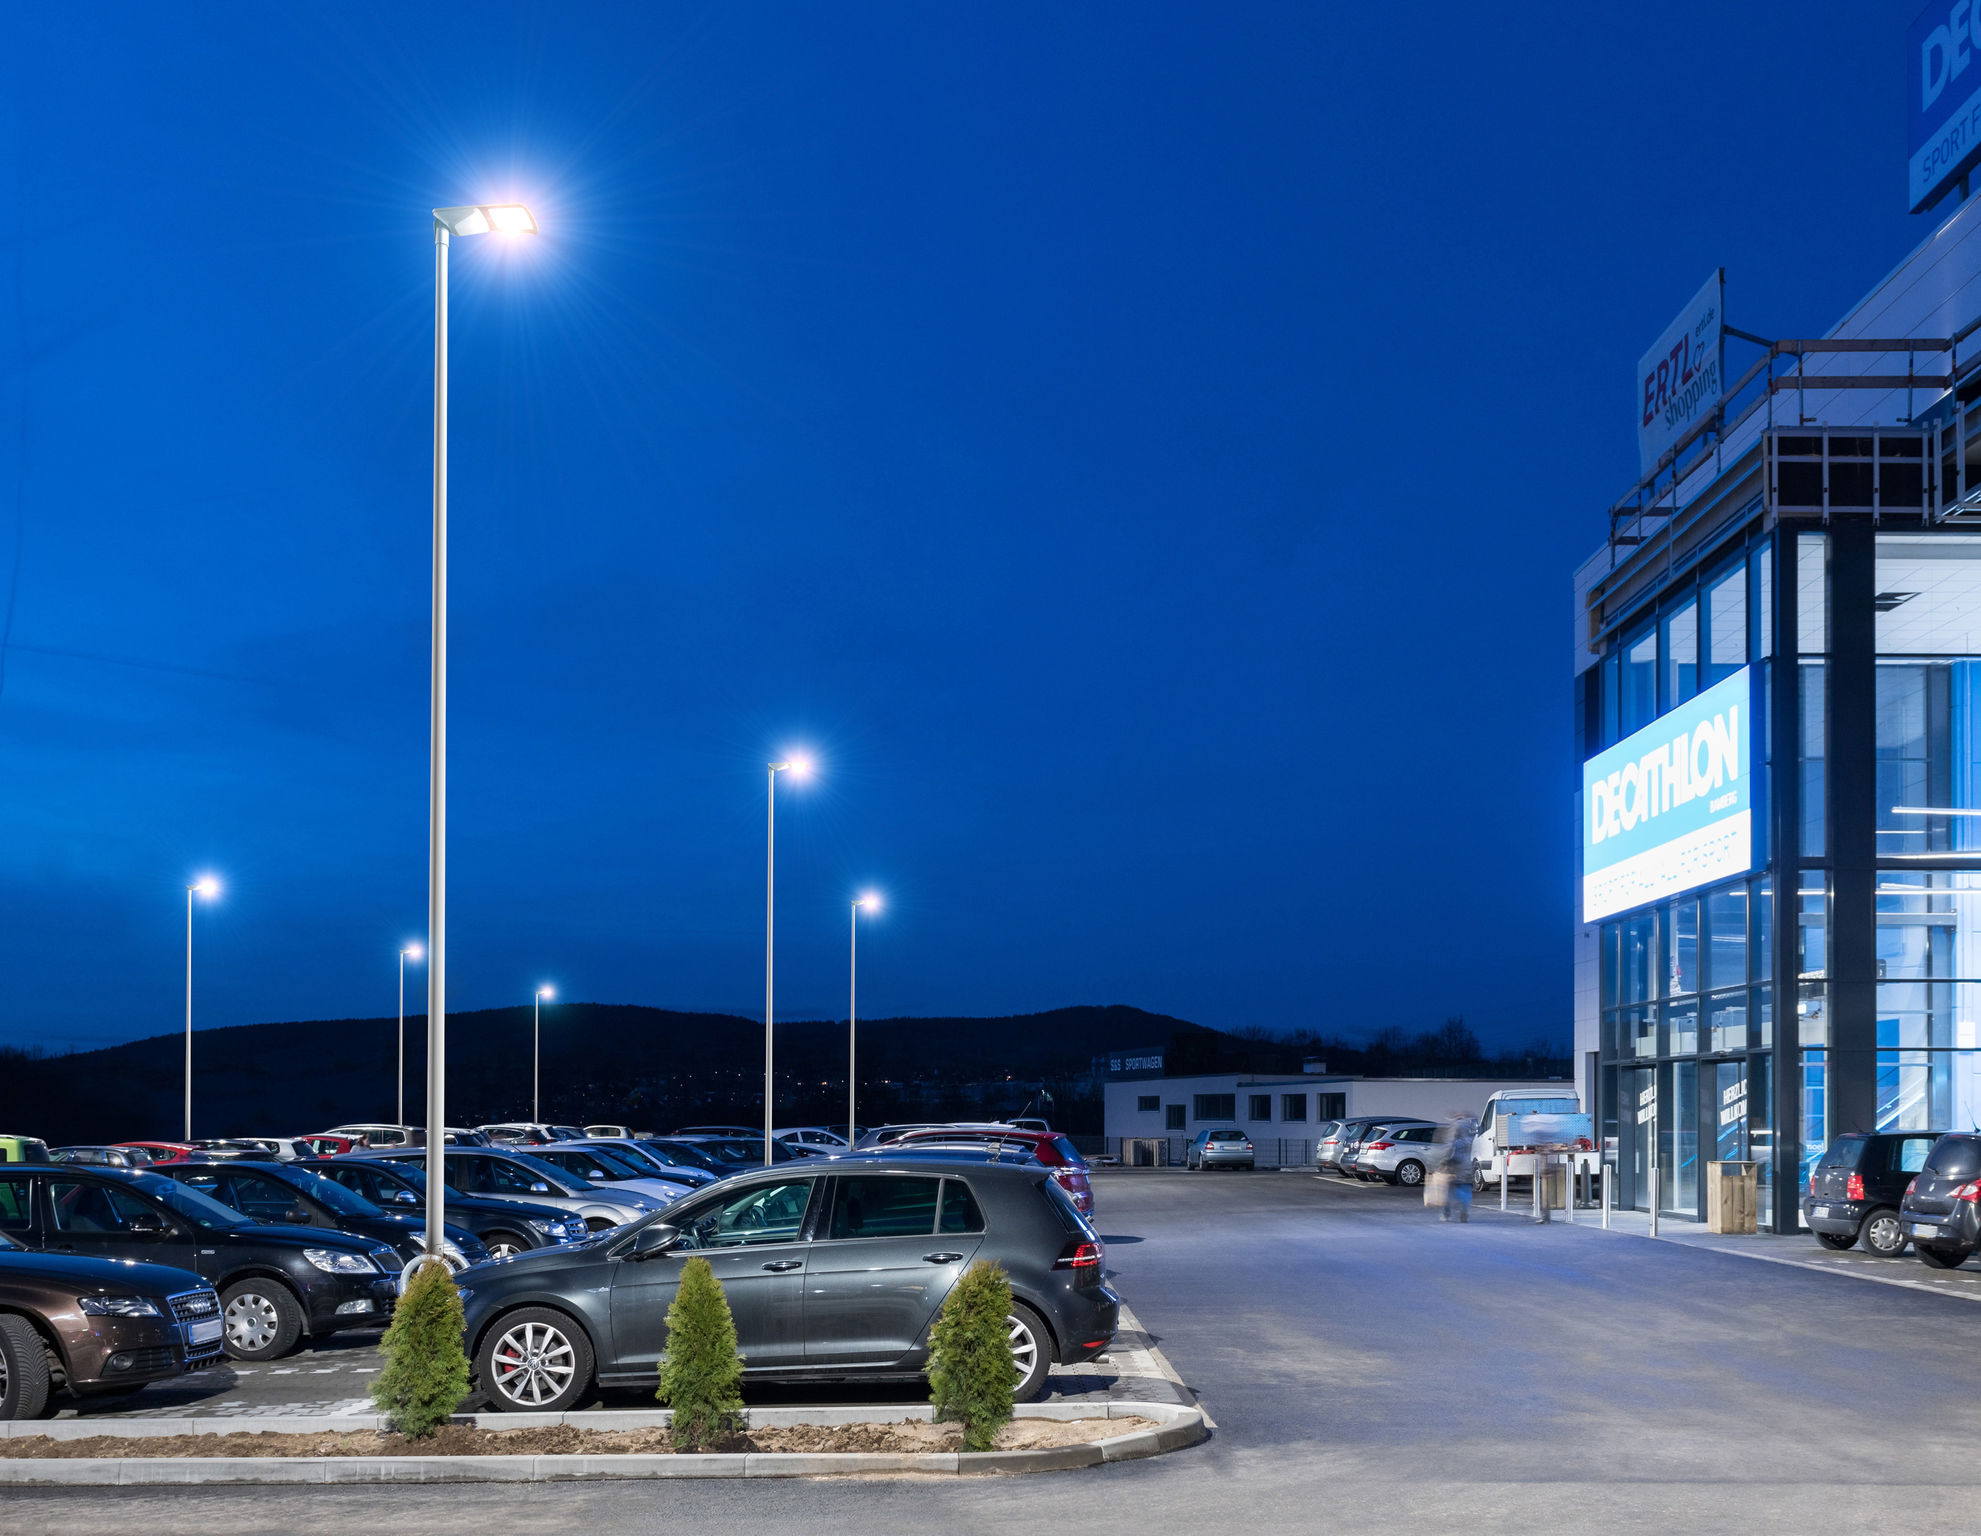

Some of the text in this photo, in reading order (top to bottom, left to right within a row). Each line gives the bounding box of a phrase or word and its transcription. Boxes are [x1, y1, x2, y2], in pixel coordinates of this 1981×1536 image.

[1922, 115, 1970, 184] SPORT
[1643, 332, 1693, 428] ERTL
[1665, 359, 1717, 431] shopping
[1591, 703, 1739, 845] DECATHLON
[1110, 1055, 1163, 1071] SSS SPORTWAGEN
